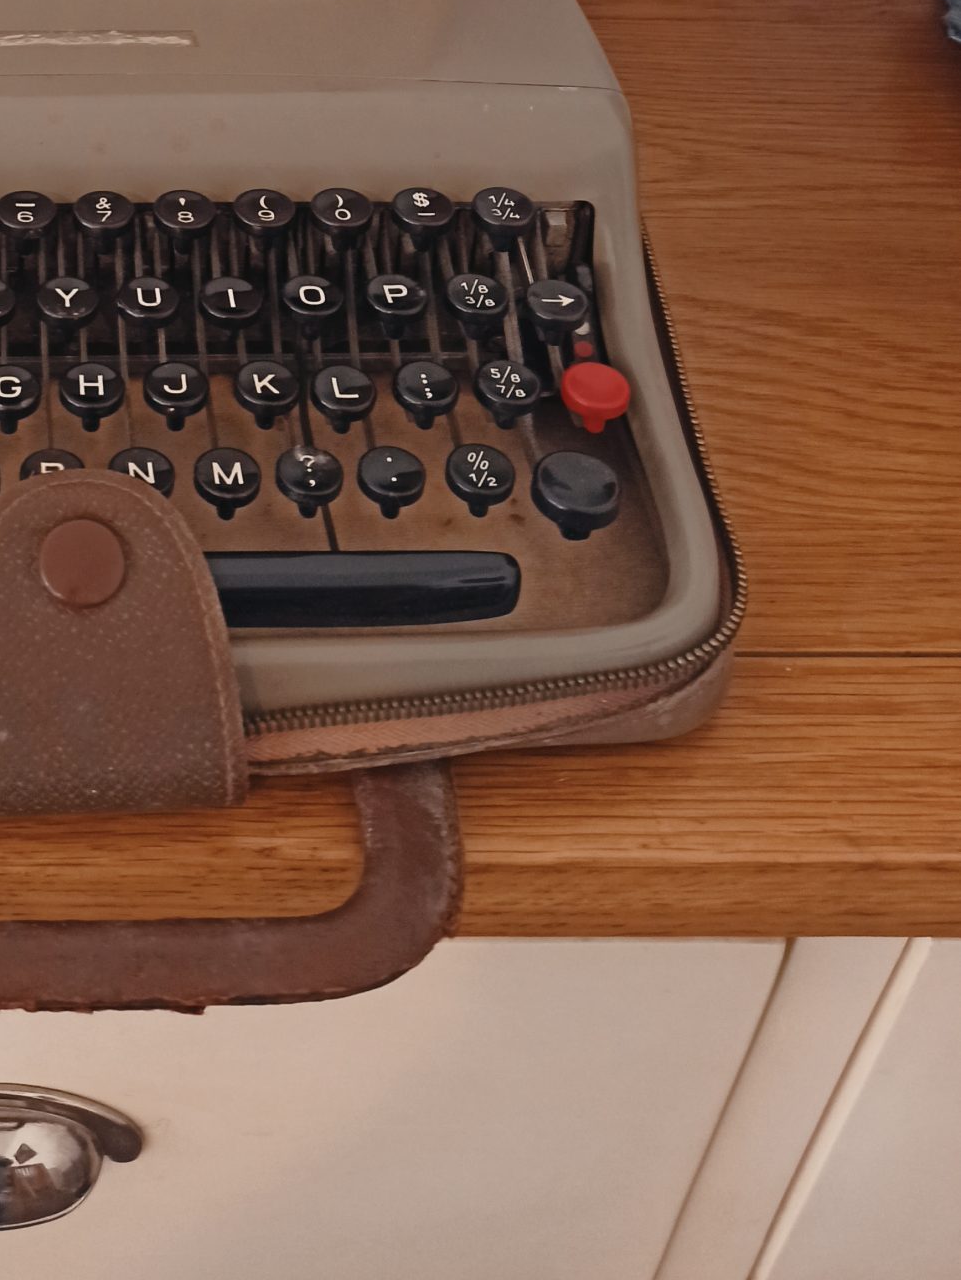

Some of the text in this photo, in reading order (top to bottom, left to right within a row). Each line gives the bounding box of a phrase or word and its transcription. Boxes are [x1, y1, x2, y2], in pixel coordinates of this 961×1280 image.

[412, 192, 430, 207] $
[17, 211, 34, 223] 6
[98, 210, 112, 222] 7
[177, 211, 195, 223] 8
[257, 209, 275, 221] 9
[334, 208, 352, 221] 0
[54, 288, 79, 308] Y
[136, 287, 162, 307] U
[227, 288, 236, 308] I
[299, 285, 326, 305] O
[382, 284, 408, 304] P
[78, 374, 105, 396] H
[163, 373, 187, 394] J
[252, 373, 280, 394] K
[331, 377, 360, 399] L
[128, 461, 155, 484] N
[212, 461, 244, 485] M
